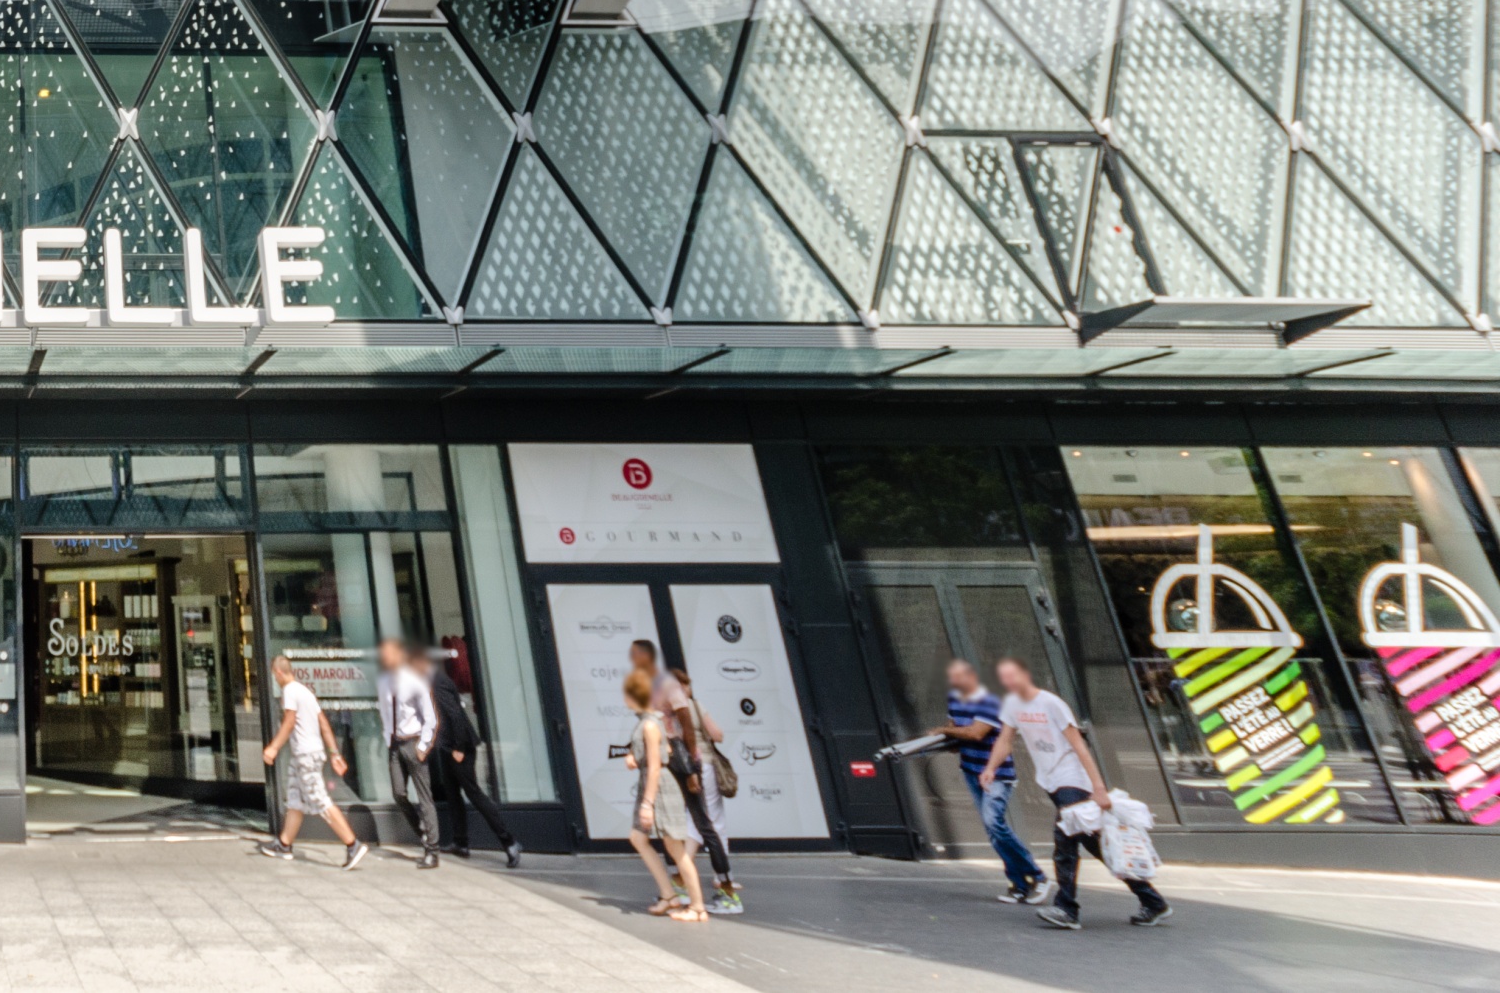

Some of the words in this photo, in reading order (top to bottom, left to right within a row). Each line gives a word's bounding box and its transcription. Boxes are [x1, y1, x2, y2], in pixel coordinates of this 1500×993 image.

[585, 530, 742, 543] GOURMAND
[1219, 686, 1271, 723] PASSEZ
[1264, 705, 1282, 721] AU
[1435, 686, 1488, 723] PASSEZ
